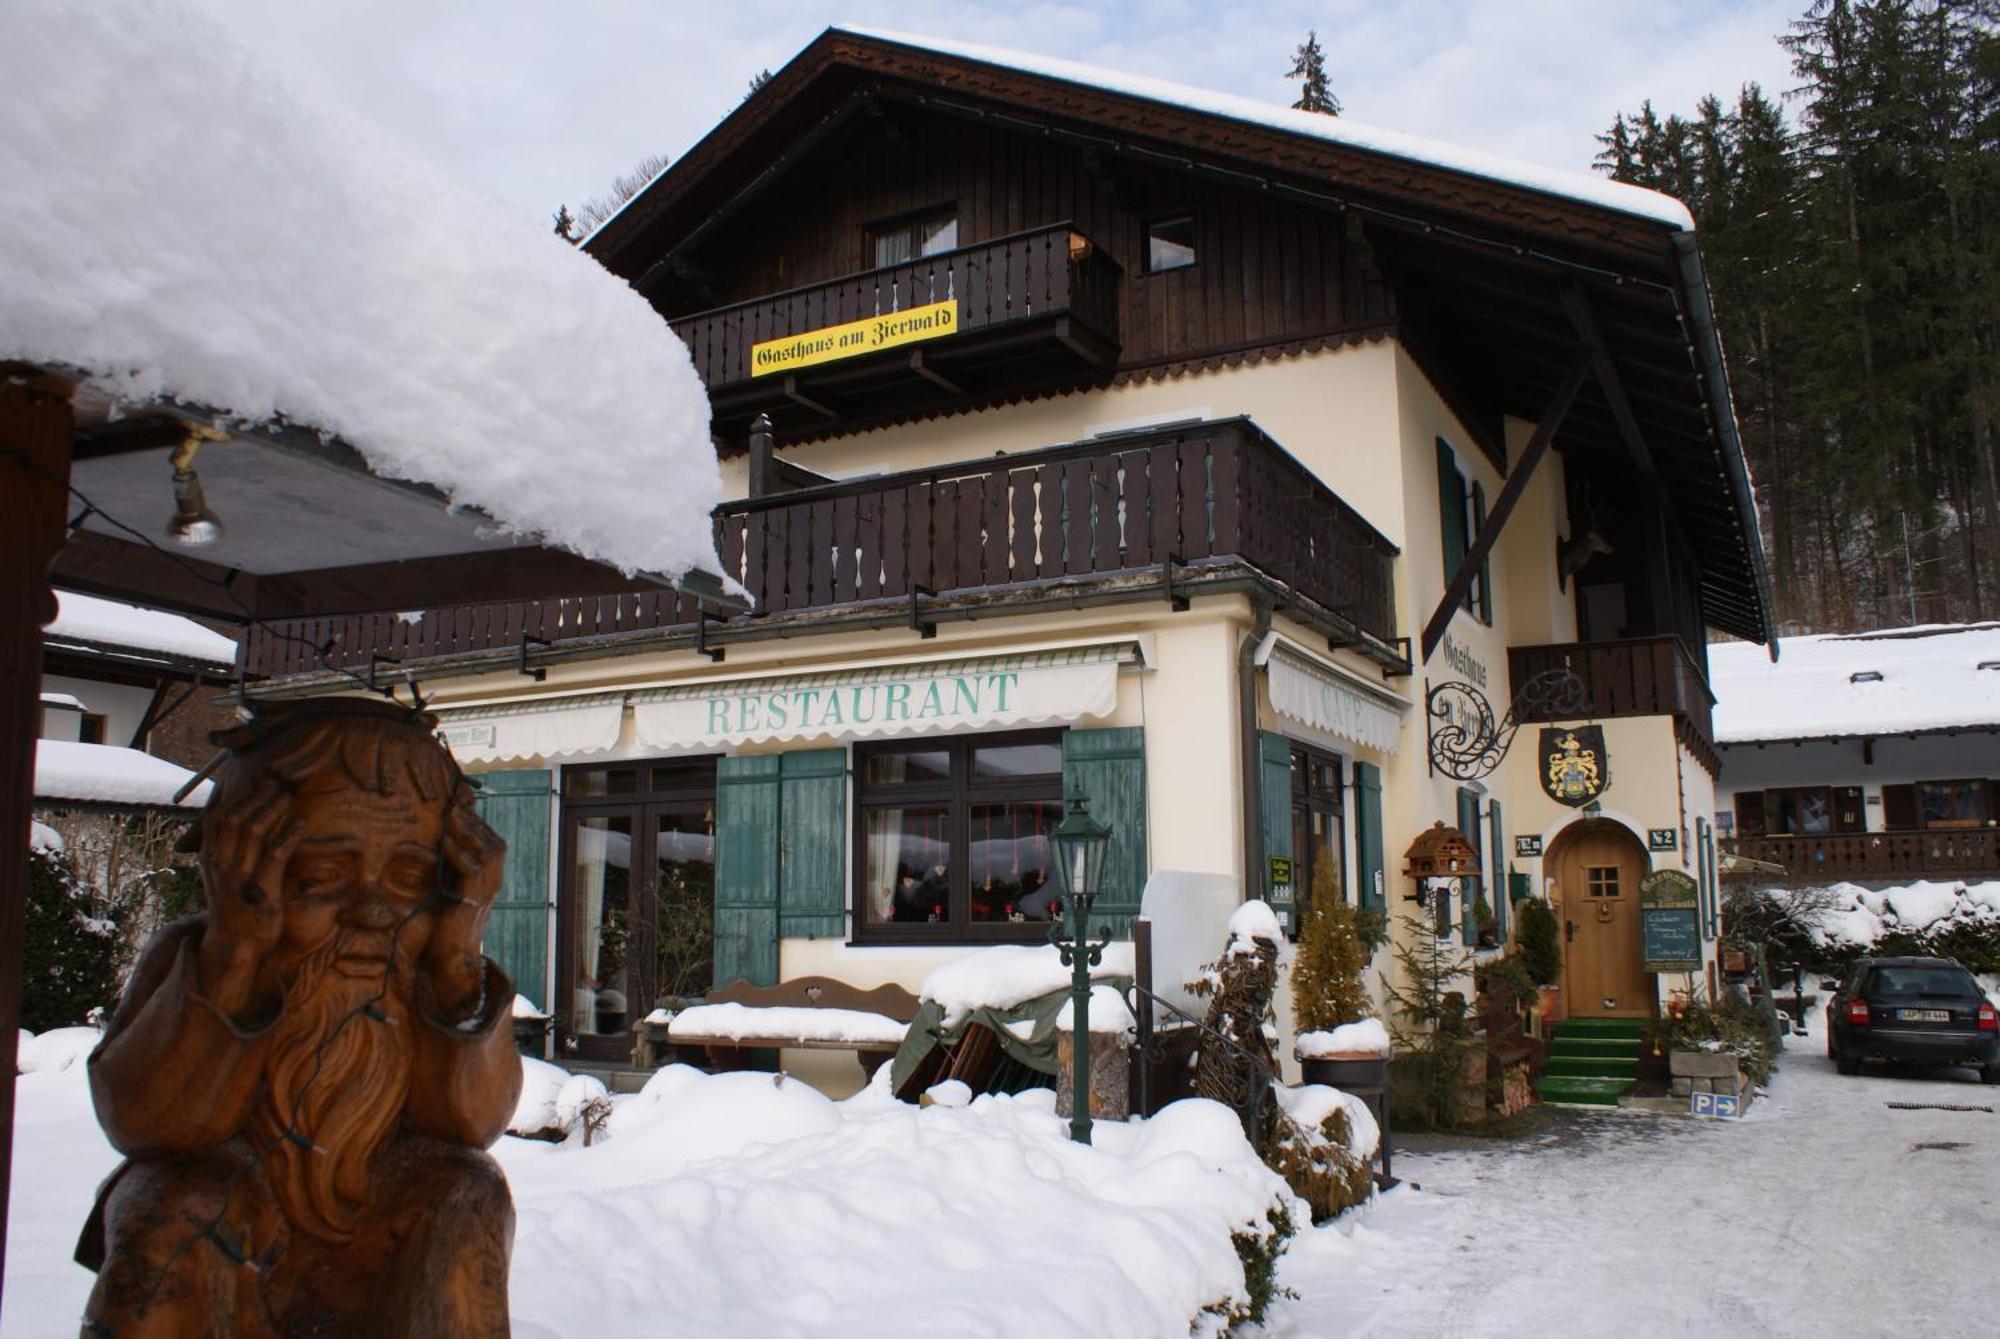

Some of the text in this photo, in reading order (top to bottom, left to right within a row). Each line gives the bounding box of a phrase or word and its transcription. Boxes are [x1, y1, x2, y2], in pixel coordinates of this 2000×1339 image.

[757, 308, 952, 367] Gasthaus am Zierwald
[704, 673, 1018, 736] RESTAURANT
[1664, 830, 1673, 844] 2
[1696, 1095, 1711, 1112] P
